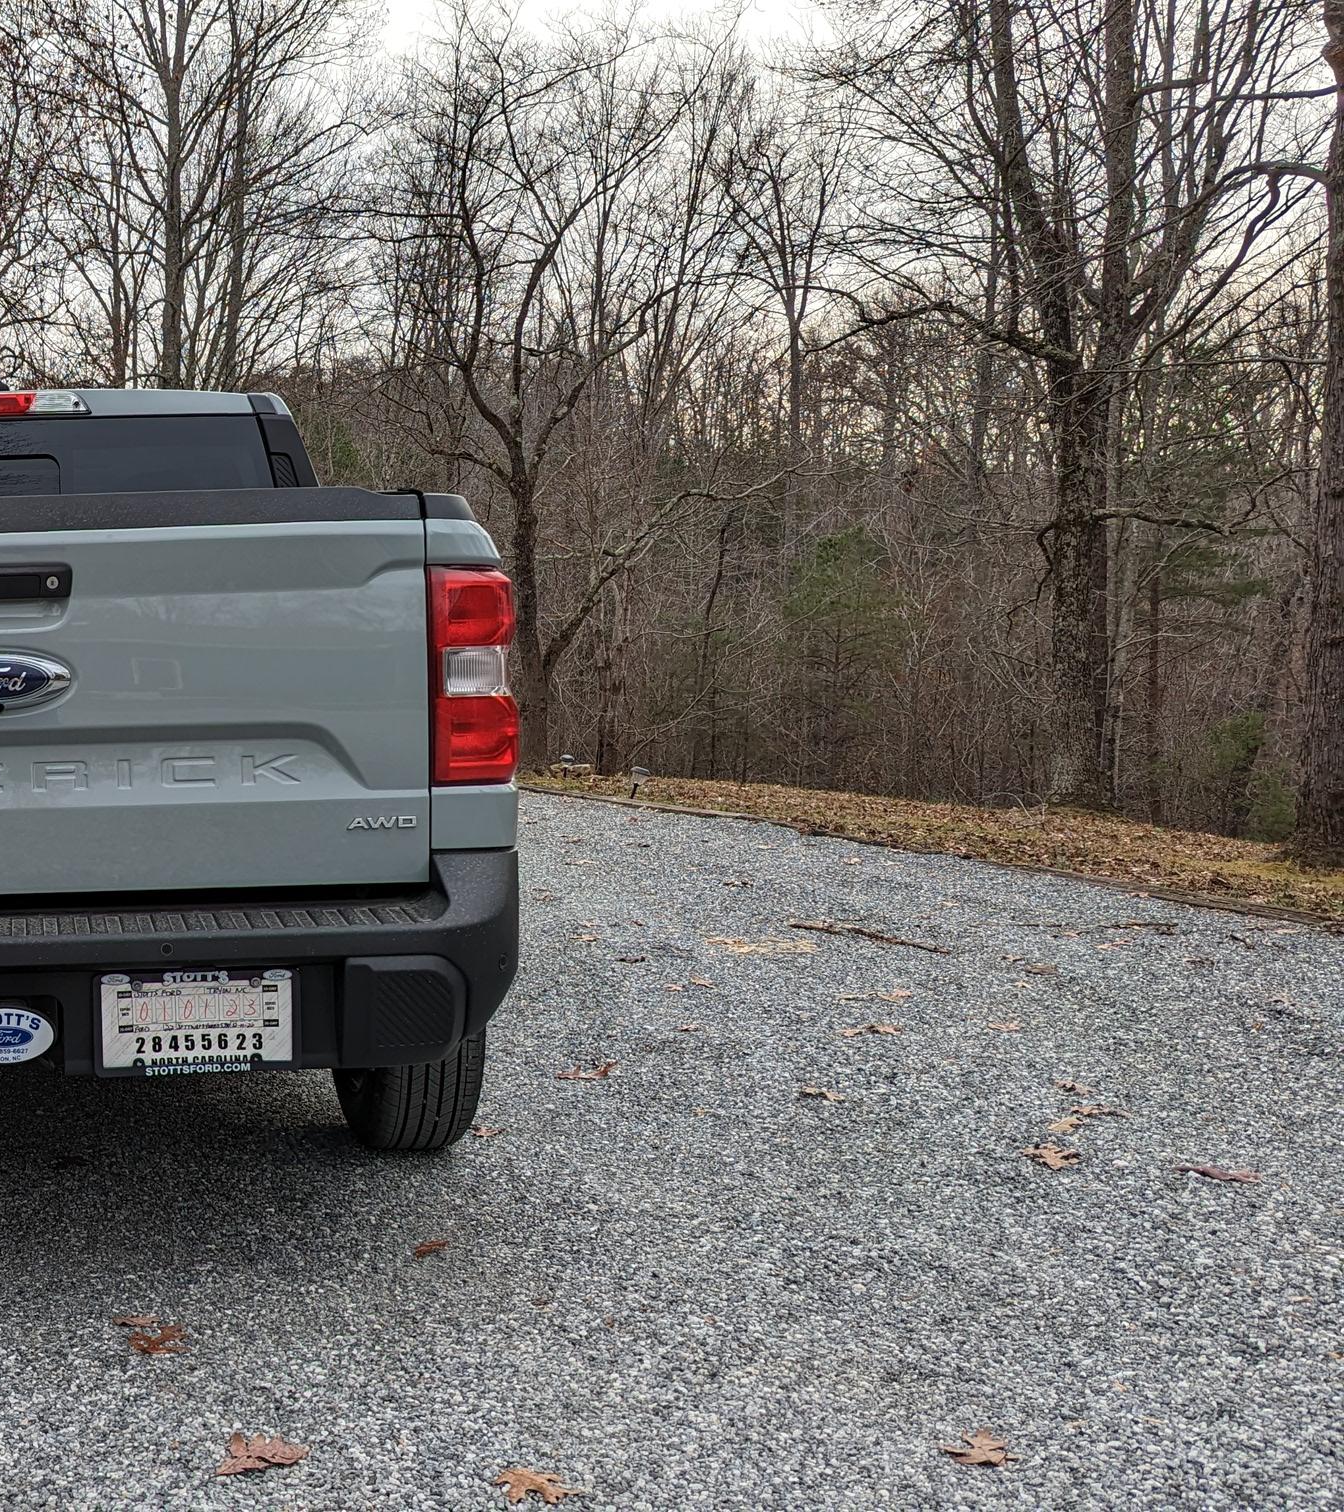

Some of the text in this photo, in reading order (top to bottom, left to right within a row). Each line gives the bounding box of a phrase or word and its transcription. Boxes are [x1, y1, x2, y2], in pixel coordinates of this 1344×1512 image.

[346, 815, 417, 830] AWD
[162, 970, 229, 986] STOTT'S
[136, 1033, 263, 1054] 28455623
[151, 1054, 249, 1065] NORTH CAROLINA
[145, 1063, 251, 1076] STOTTSFORD.COM
